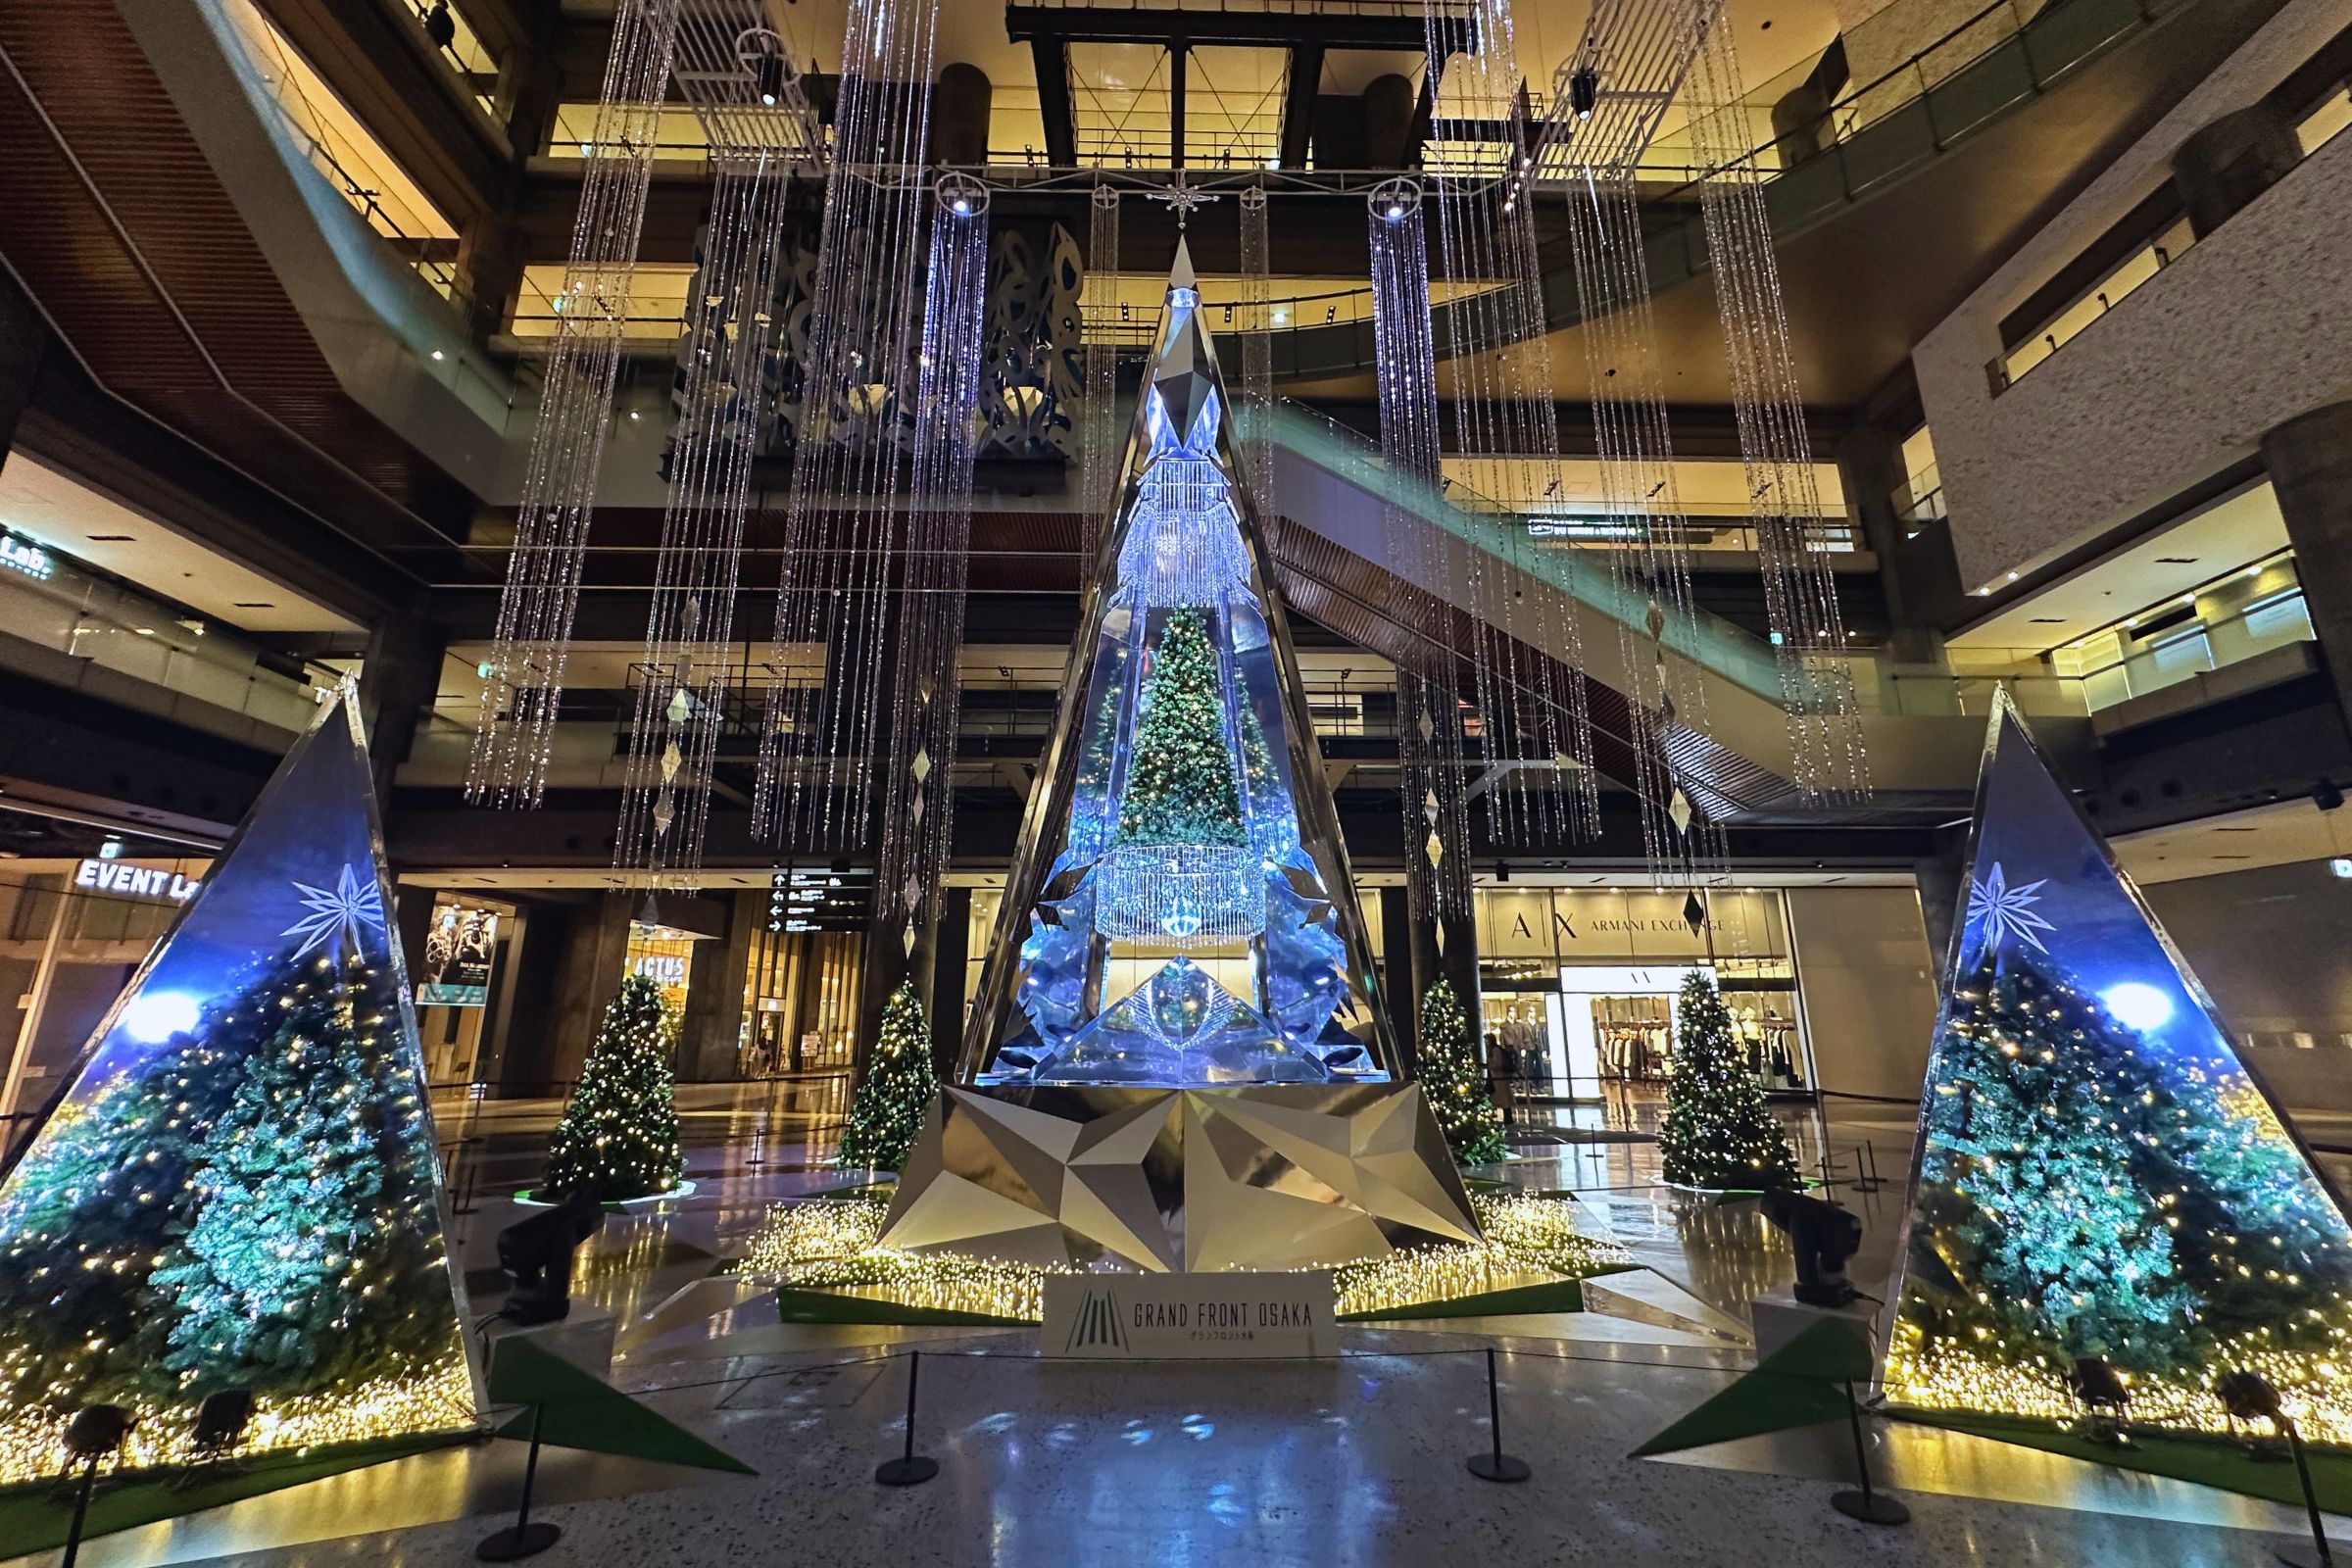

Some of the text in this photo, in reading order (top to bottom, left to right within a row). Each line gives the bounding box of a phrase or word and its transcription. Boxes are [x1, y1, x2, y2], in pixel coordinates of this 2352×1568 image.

[75, 858, 169, 896] EVENT
[1590, 919, 1726, 932] ARMANI EXCHGE
[633, 956, 684, 977] ACTUS
[1134, 1301, 1312, 1327] GRAND FRONT OSAKA
